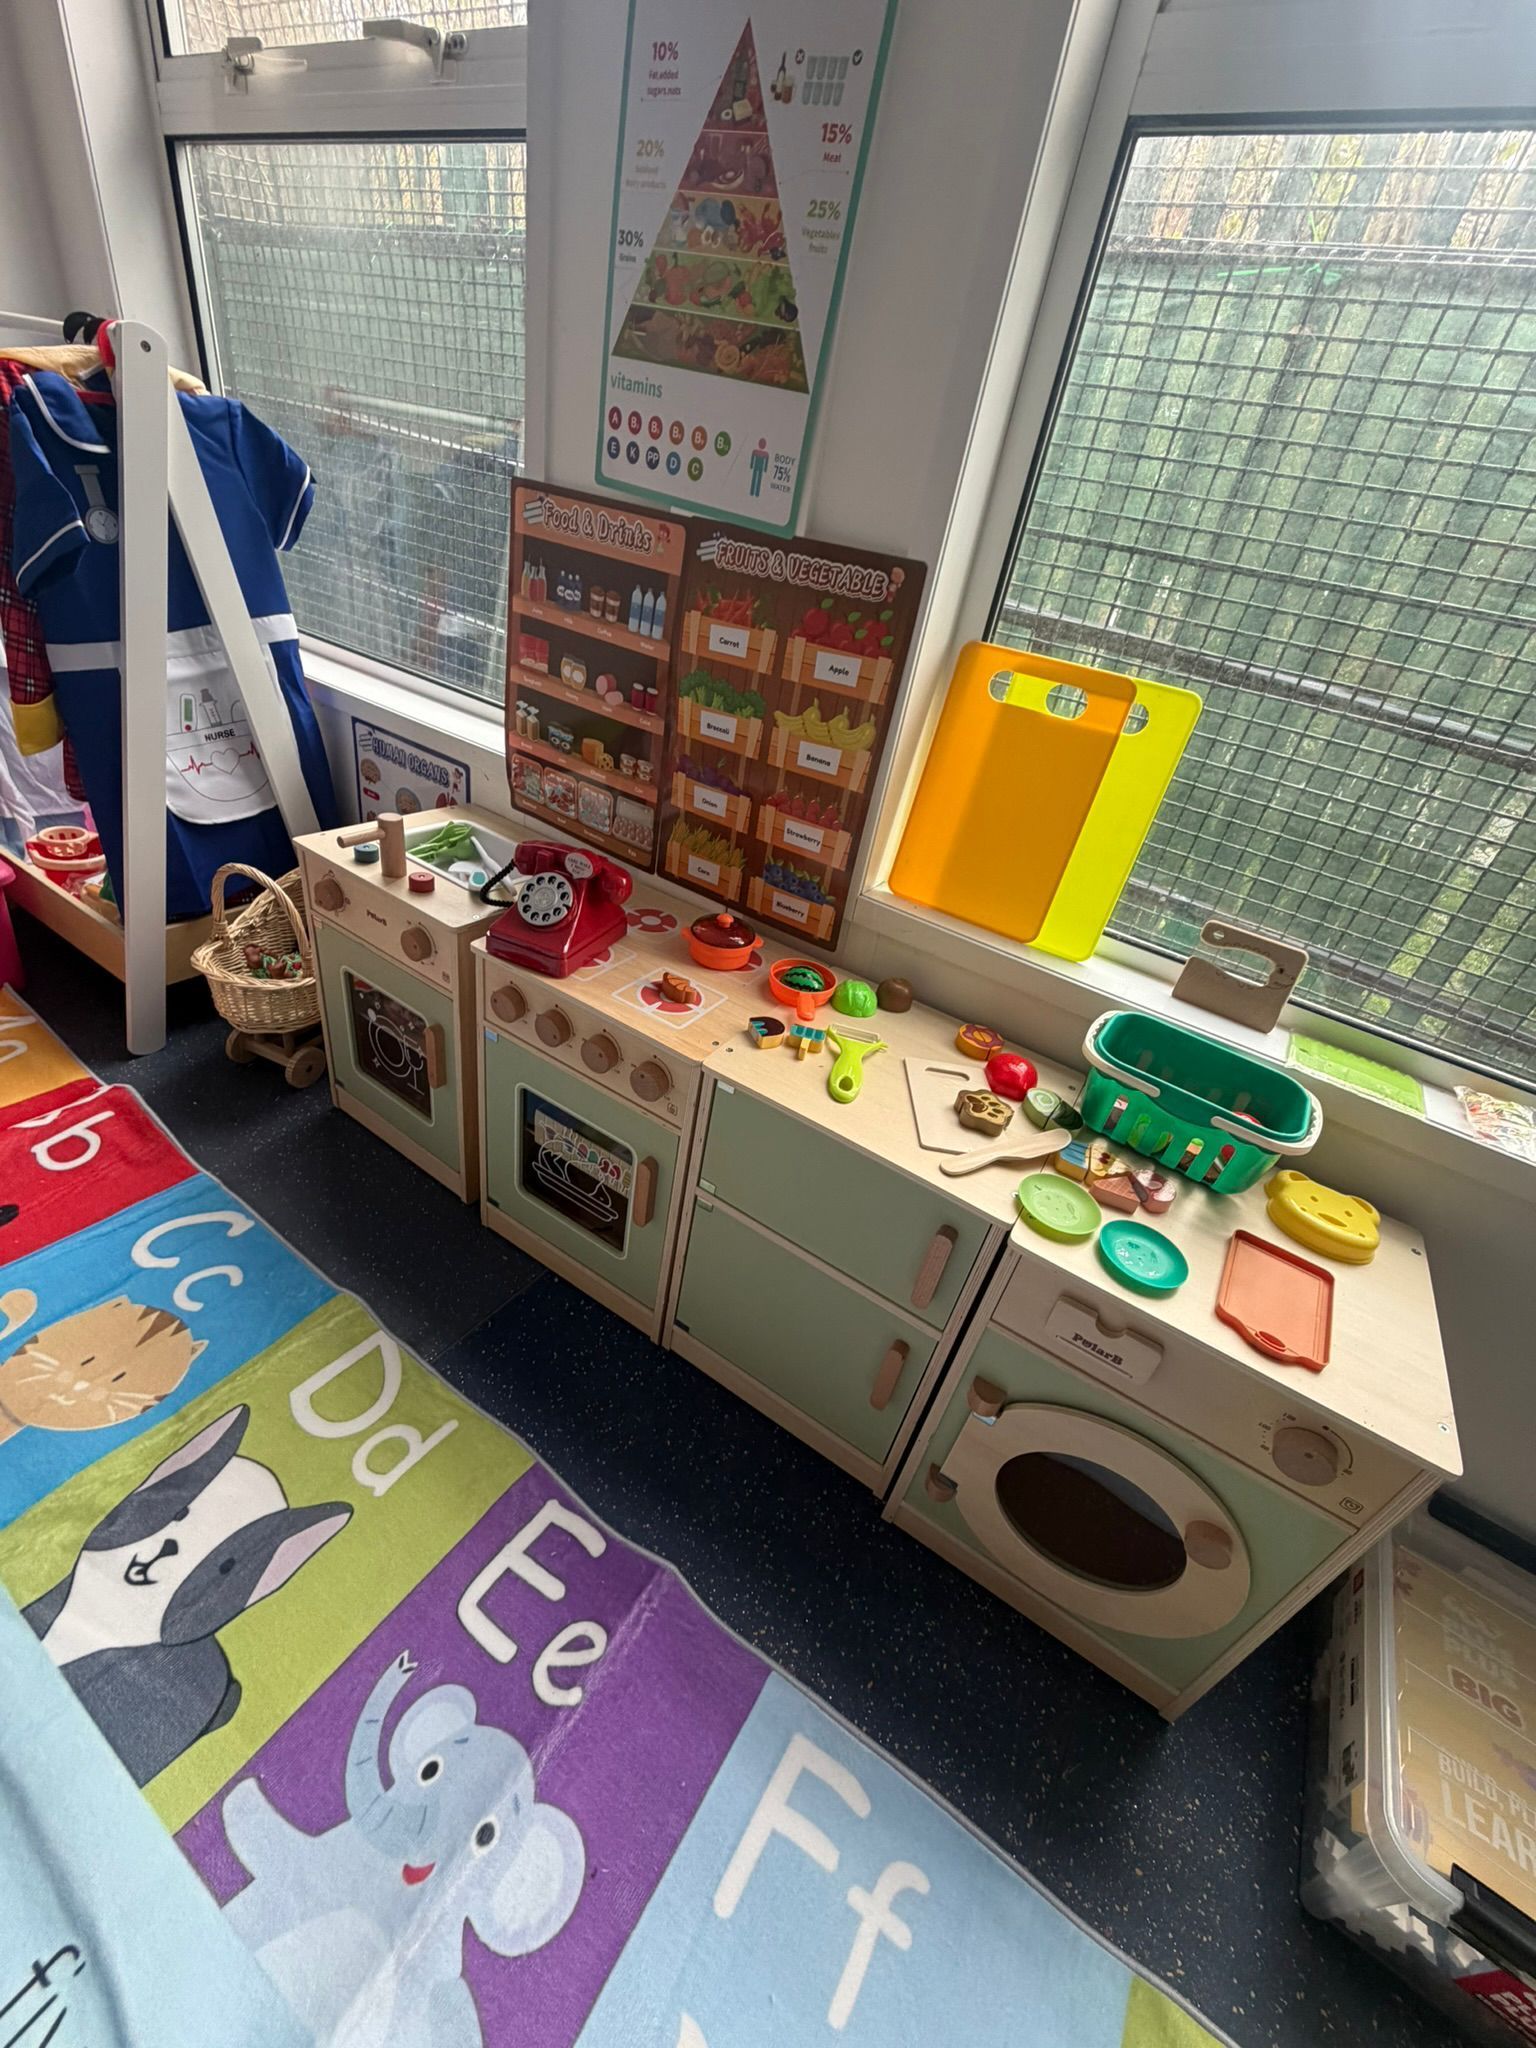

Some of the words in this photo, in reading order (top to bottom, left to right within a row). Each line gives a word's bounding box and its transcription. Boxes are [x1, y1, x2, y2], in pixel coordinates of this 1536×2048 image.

[652, 41, 679, 61] 10%
[821, 123, 852, 144] 15%
[637, 140, 664, 158] 20%
[823, 152, 842, 163] Meat
[807, 200, 841, 220] 25%
[618, 230, 643, 247] 30%
[611, 372, 663, 398] vitamins
[774, 453, 796, 465] BODY
[773, 466, 791, 482] 75%
[770, 483, 791, 493] WATER
[543, 499, 580, 533] Food
[581, 508, 595, 537] &
[598, 511, 653, 553] Drinks
[715, 539, 771, 577] FRUITS
[771, 550, 786, 582] &
[787, 553, 889, 602] VEGETABLE
[719, 636, 740, 649] Carrot
[828, 664, 850, 677] Apple
[204, 728, 236, 742] NURSE
[706, 722, 730, 735] Broccoli
[371, 736, 406, 769] HUMAN
[407, 752, 450, 788] ORGANS
[806, 754, 831, 767] Banana
[786, 828, 821, 847] Strawberry
[775, 901, 805, 918] Blueberry
[289, 1331, 458, 1496] Dd
[456, 1499, 607, 1706] Ee
[1449, 1665, 1524, 1730] BIG
[714, 1734, 930, 2028] Ff
